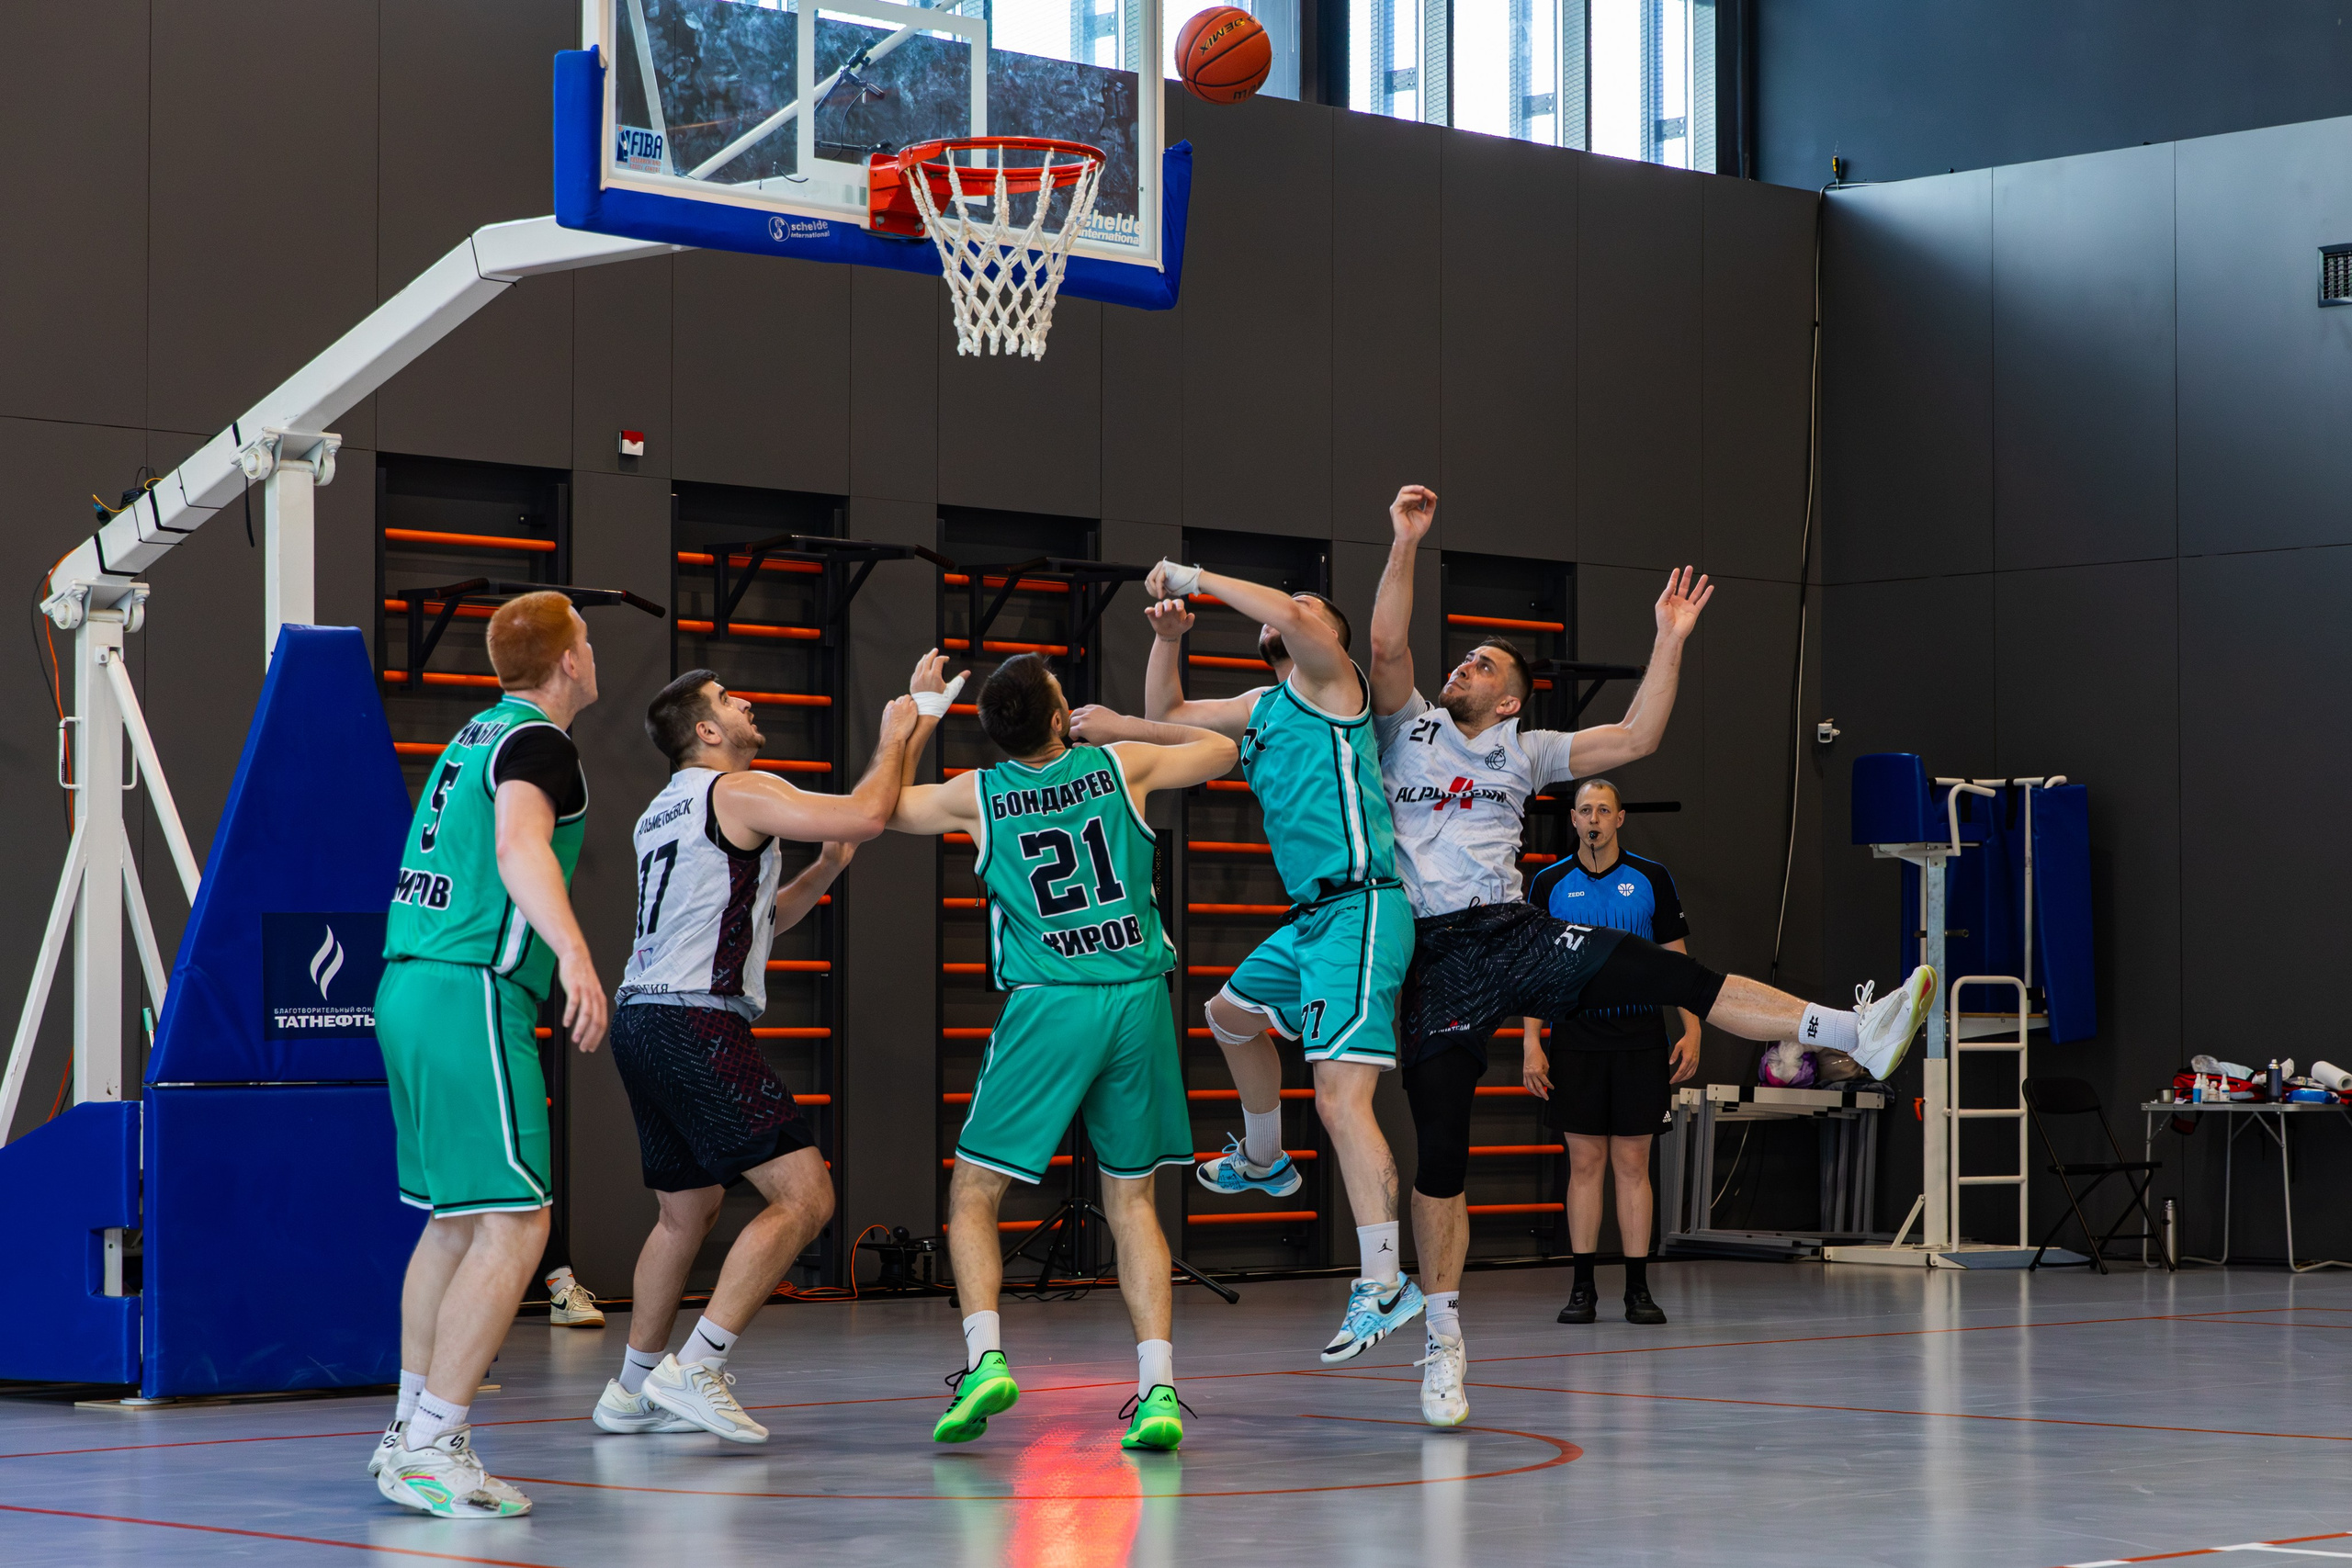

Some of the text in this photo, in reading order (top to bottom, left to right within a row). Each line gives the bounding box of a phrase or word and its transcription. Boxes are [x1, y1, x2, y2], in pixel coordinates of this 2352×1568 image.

[1199, 18, 1246, 56] DEMIX
[630, 131, 662, 160] FIBA
[791, 220, 829, 231] schelde
[791, 231, 830, 239] international
[1408, 718, 1442, 746] 21
[420, 759, 464, 853] 5
[991, 770, 1116, 820] БОНДАРЕВ
[1018, 816, 1125, 918] 21
[392, 867, 454, 910] ИРОВ
[638, 839, 679, 939] 17
[1567, 890, 1585, 898] ZEDO
[274, 1007, 355, 1015] БЛАГОТВОРИТЕЛЬНЫЙ
[274, 1014, 376, 1028] ТАТНЕФТЬ
